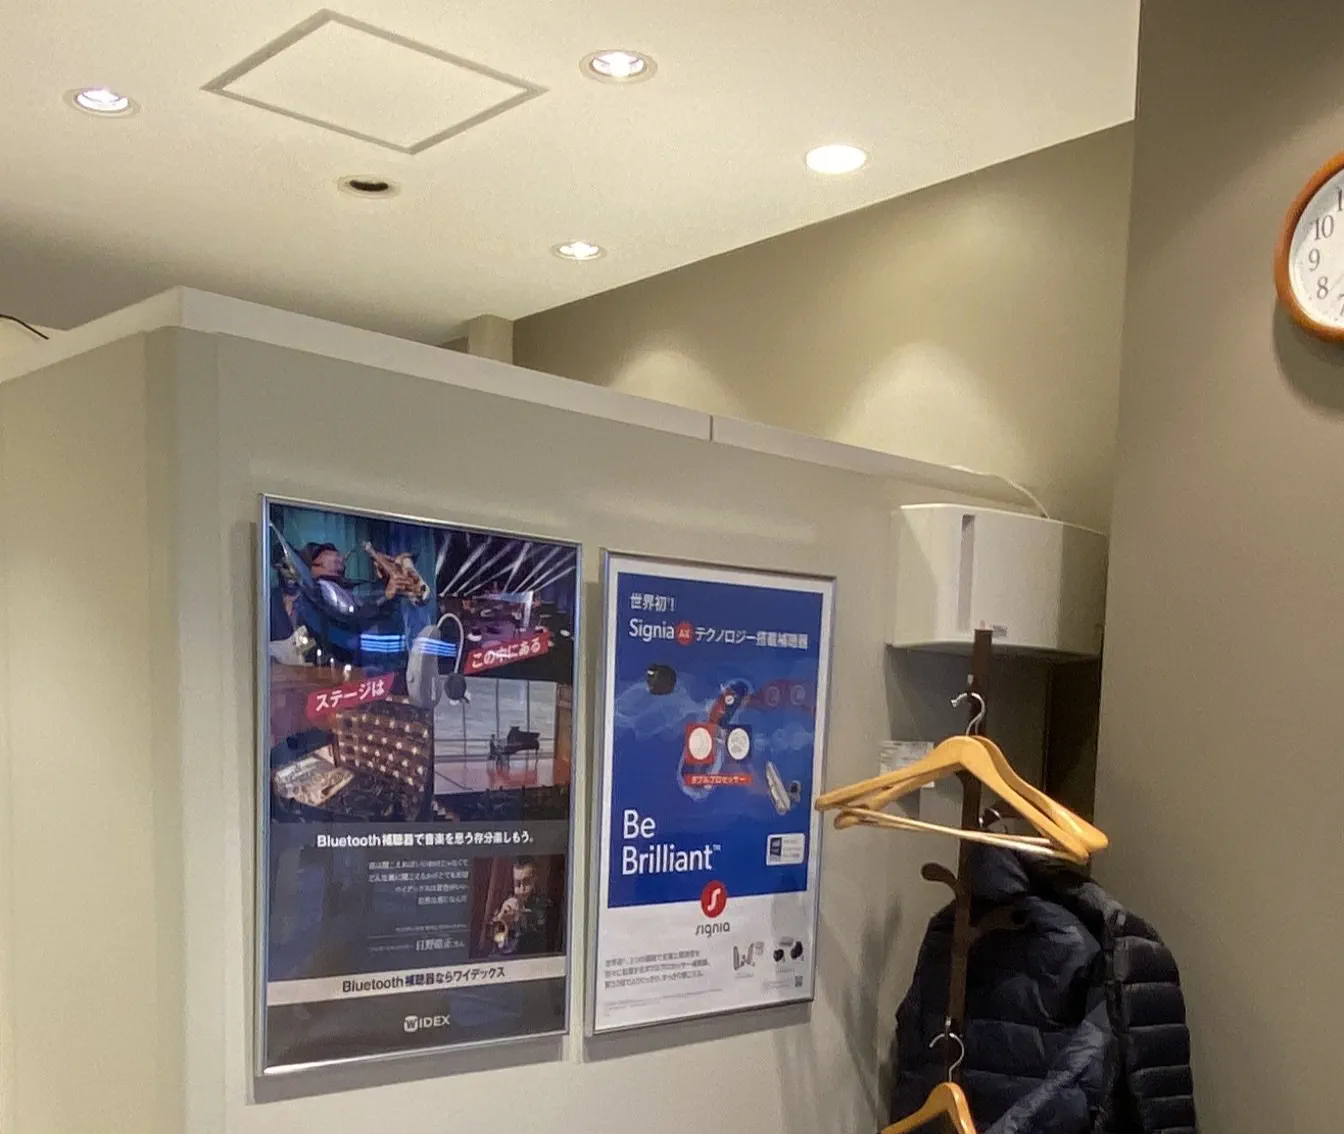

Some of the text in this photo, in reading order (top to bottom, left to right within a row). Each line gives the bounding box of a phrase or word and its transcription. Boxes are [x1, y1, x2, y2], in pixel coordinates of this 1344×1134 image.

[1313, 214, 1334, 241] 10
[1308, 248, 1320, 272] 9
[1316, 276, 1329, 300] 8
[629, 618, 675, 642] Signia
[471, 638, 542, 668] この中にある
[316, 679, 384, 712] ステージは
[623, 809, 656, 840] Be
[694, 921, 731, 938] signia
[342, 966, 506, 993] Bluetooth補聴器ならワイデックス
[404, 1014, 451, 1033] WIDEX
